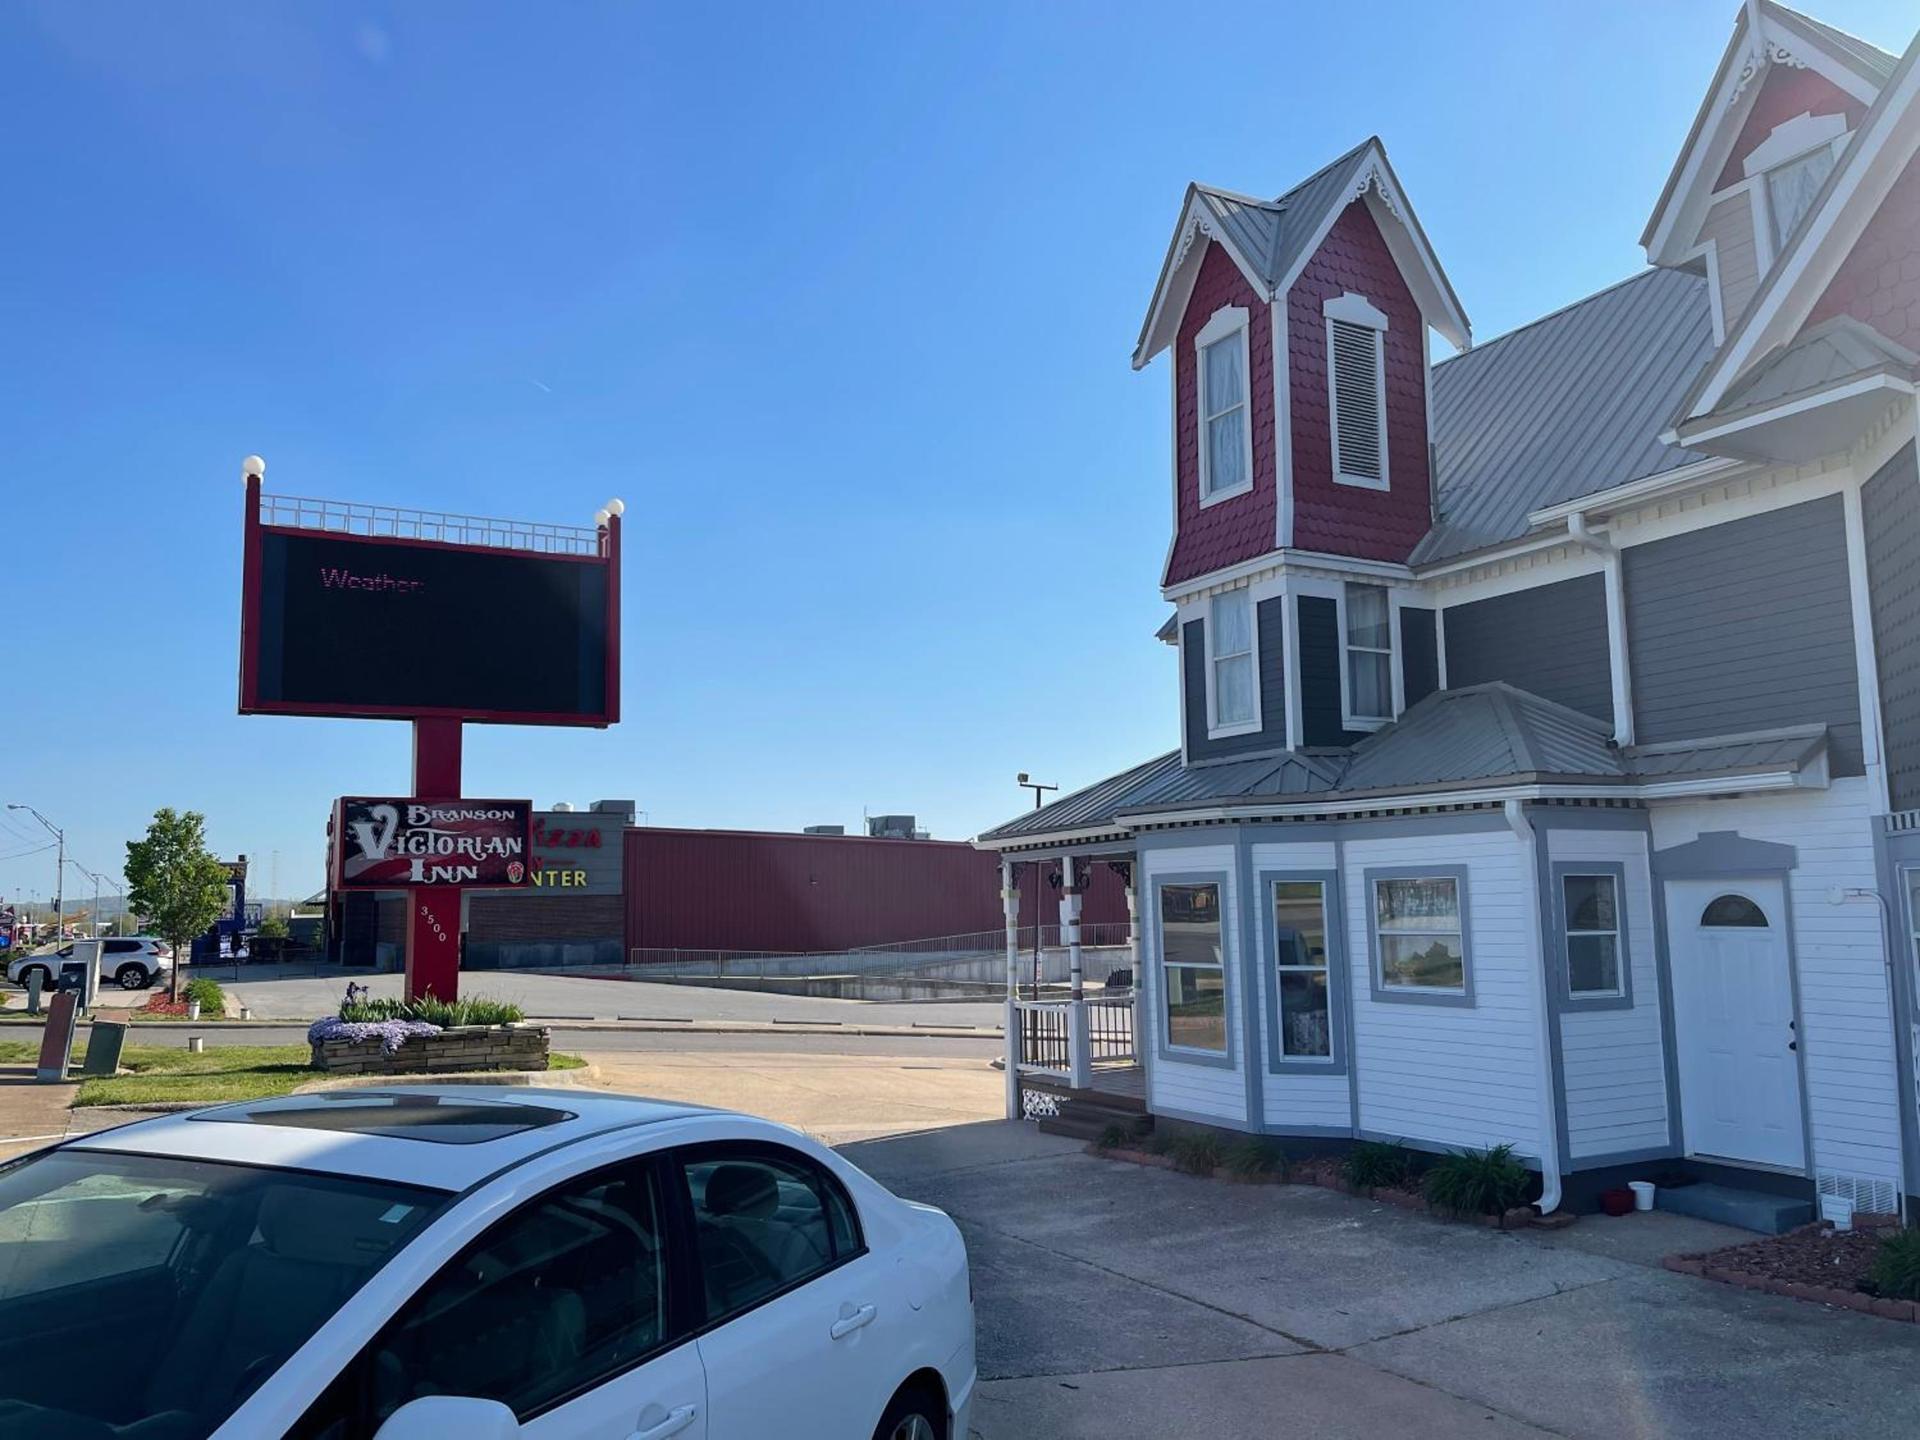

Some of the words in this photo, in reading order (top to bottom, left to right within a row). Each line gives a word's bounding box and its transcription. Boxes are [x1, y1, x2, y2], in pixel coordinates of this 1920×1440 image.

[532, 817, 602, 848] izza
[531, 870, 587, 887] NTER
[421, 906, 446, 942] 3500
